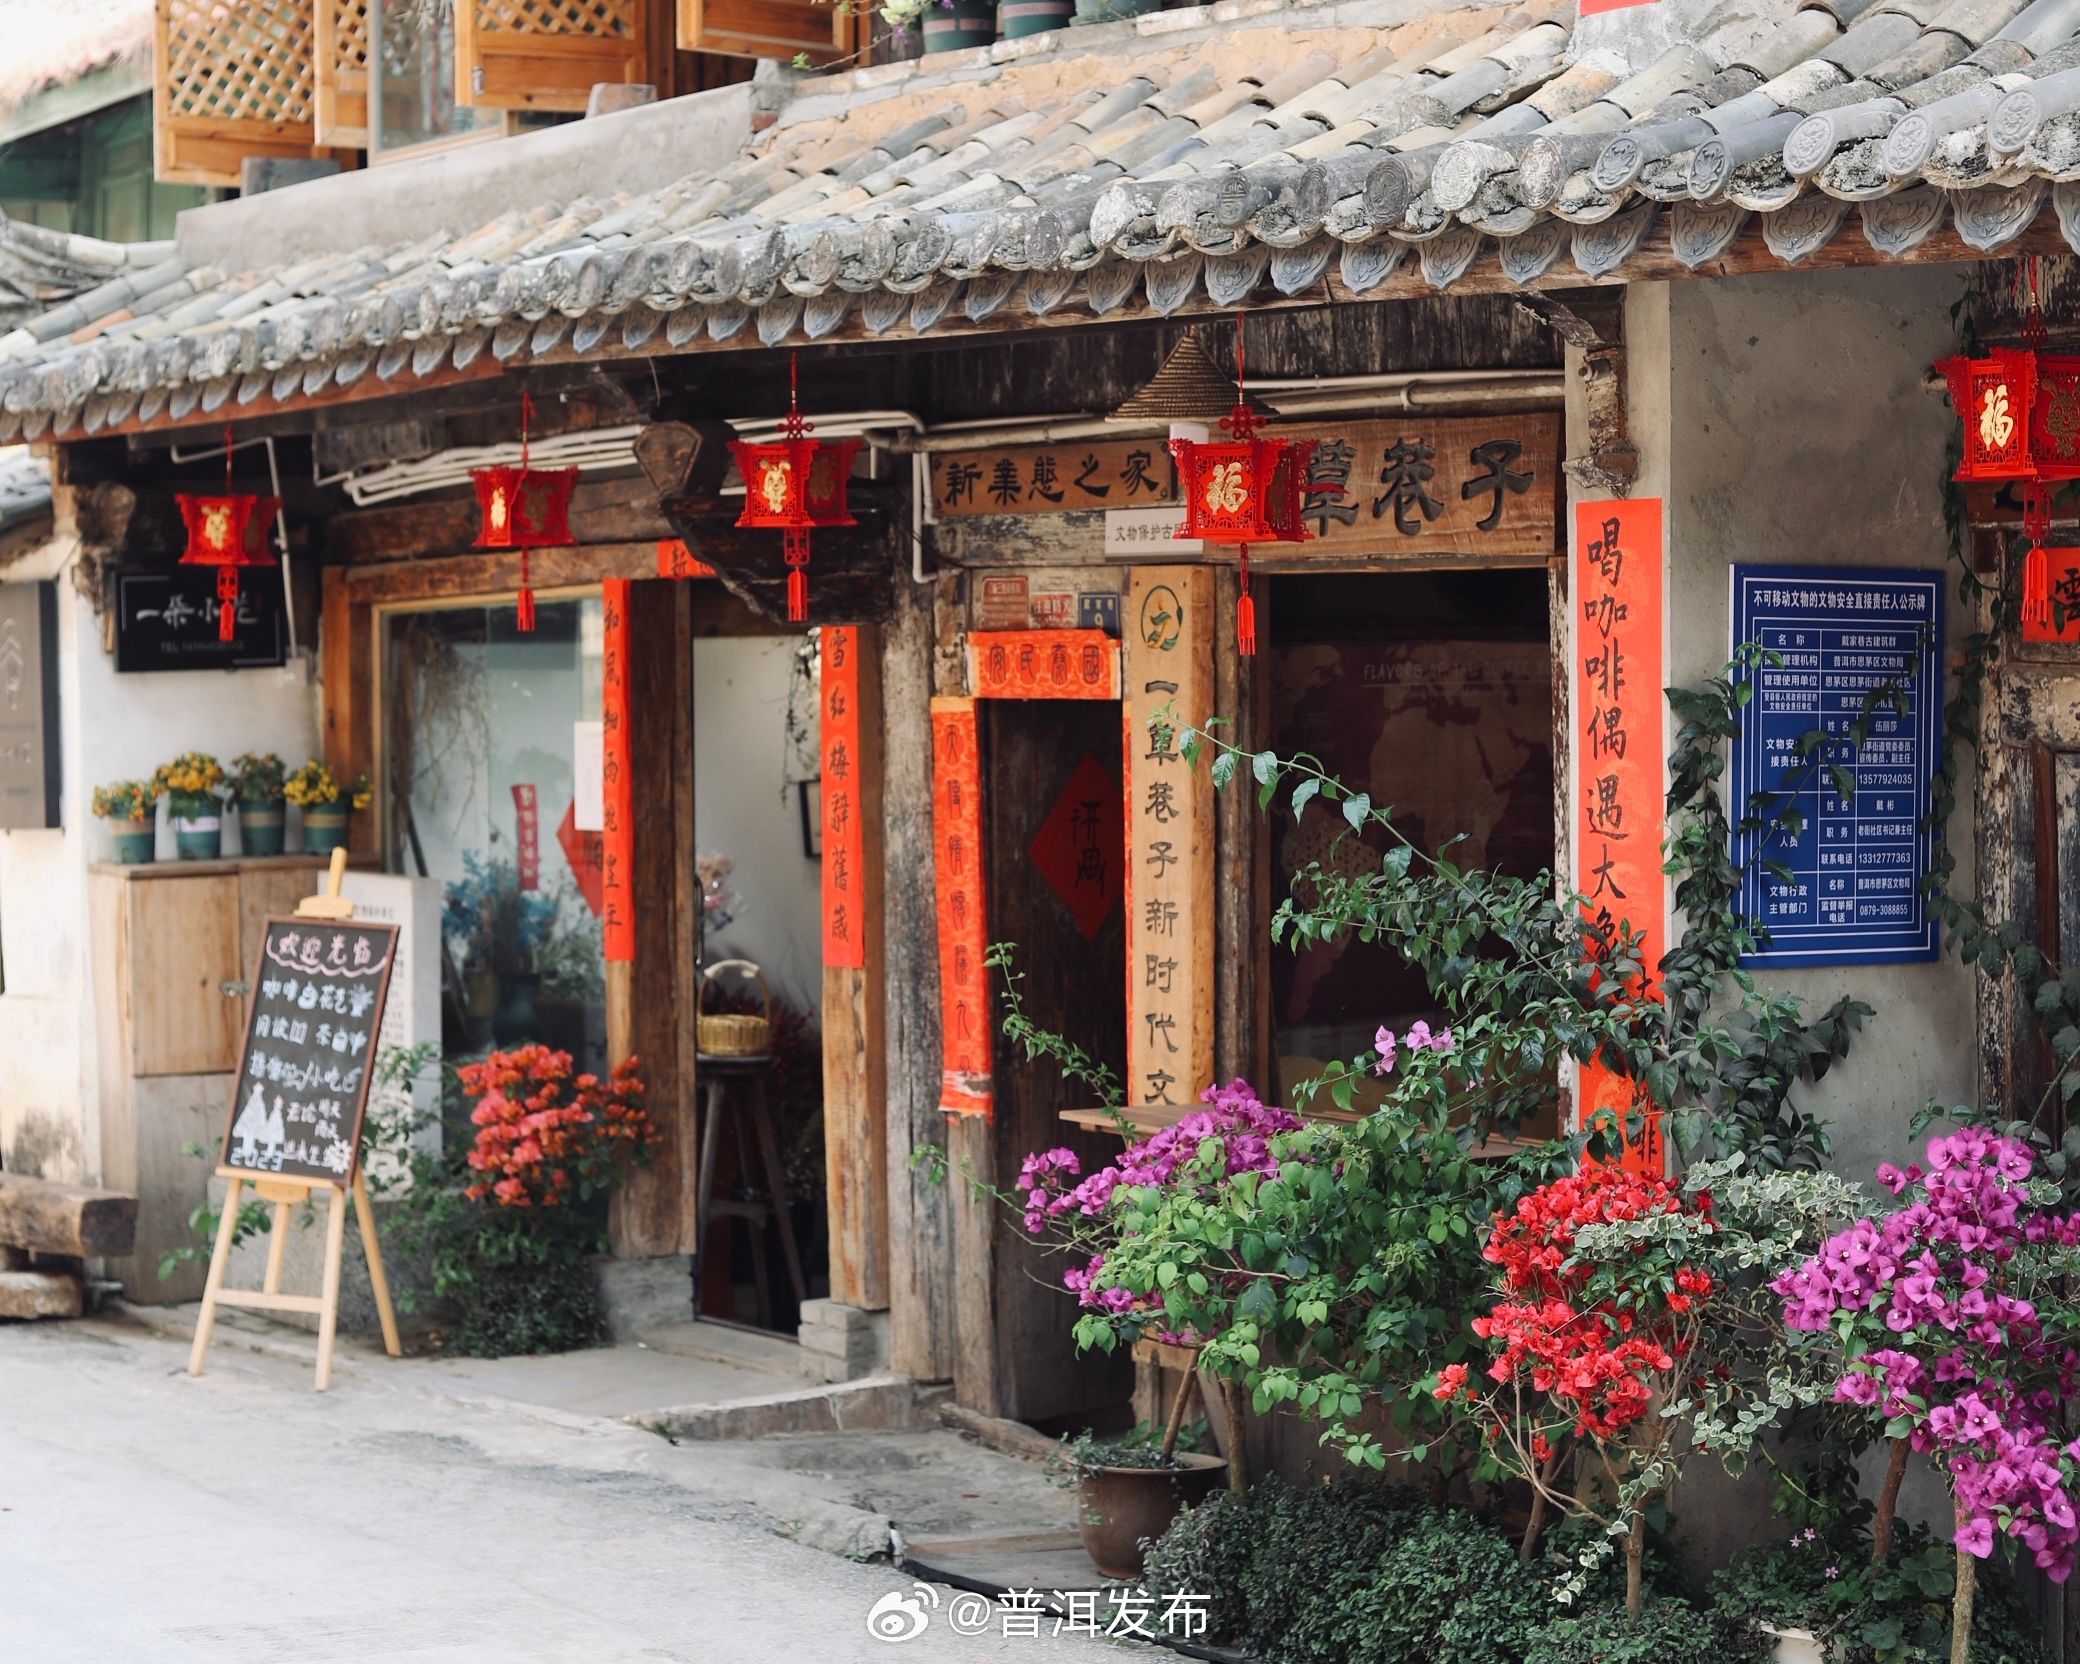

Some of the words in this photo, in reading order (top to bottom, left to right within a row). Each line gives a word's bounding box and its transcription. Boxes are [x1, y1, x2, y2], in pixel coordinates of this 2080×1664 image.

[1980, 384, 2014, 450] 福
[1206, 462, 1248, 515] 福
[1754, 590, 1926, 611] 不可移动文物的文物安全直接责任人公示牌
[1765, 655, 1818, 667] 管理机构
[1834, 656, 1904, 668] 普洱市思茅区文物局
[1363, 662, 1423, 680] FLAVORS
[1764, 675, 1818, 687] 管理使用单位
[1841, 697, 1895, 710] 思茅区街道
[1771, 756, 1808, 768] 接责任人
[1858, 774, 1913, 785] 13577924035
[1821, 853, 1853, 865] 联系电话
[1858, 852, 1911, 864] 13312777363
[1829, 879, 1845, 891] 名称
[1858, 877, 1911, 890] 普洱市思茅区文物局
[1769, 885, 1808, 897] 文物行政
[1769, 902, 1808, 914] 主管部门
[1821, 900, 1853, 911] 监督举报
[1859, 904, 1908, 916] 0879-3088855
[1829, 912, 1845, 923] 电话
